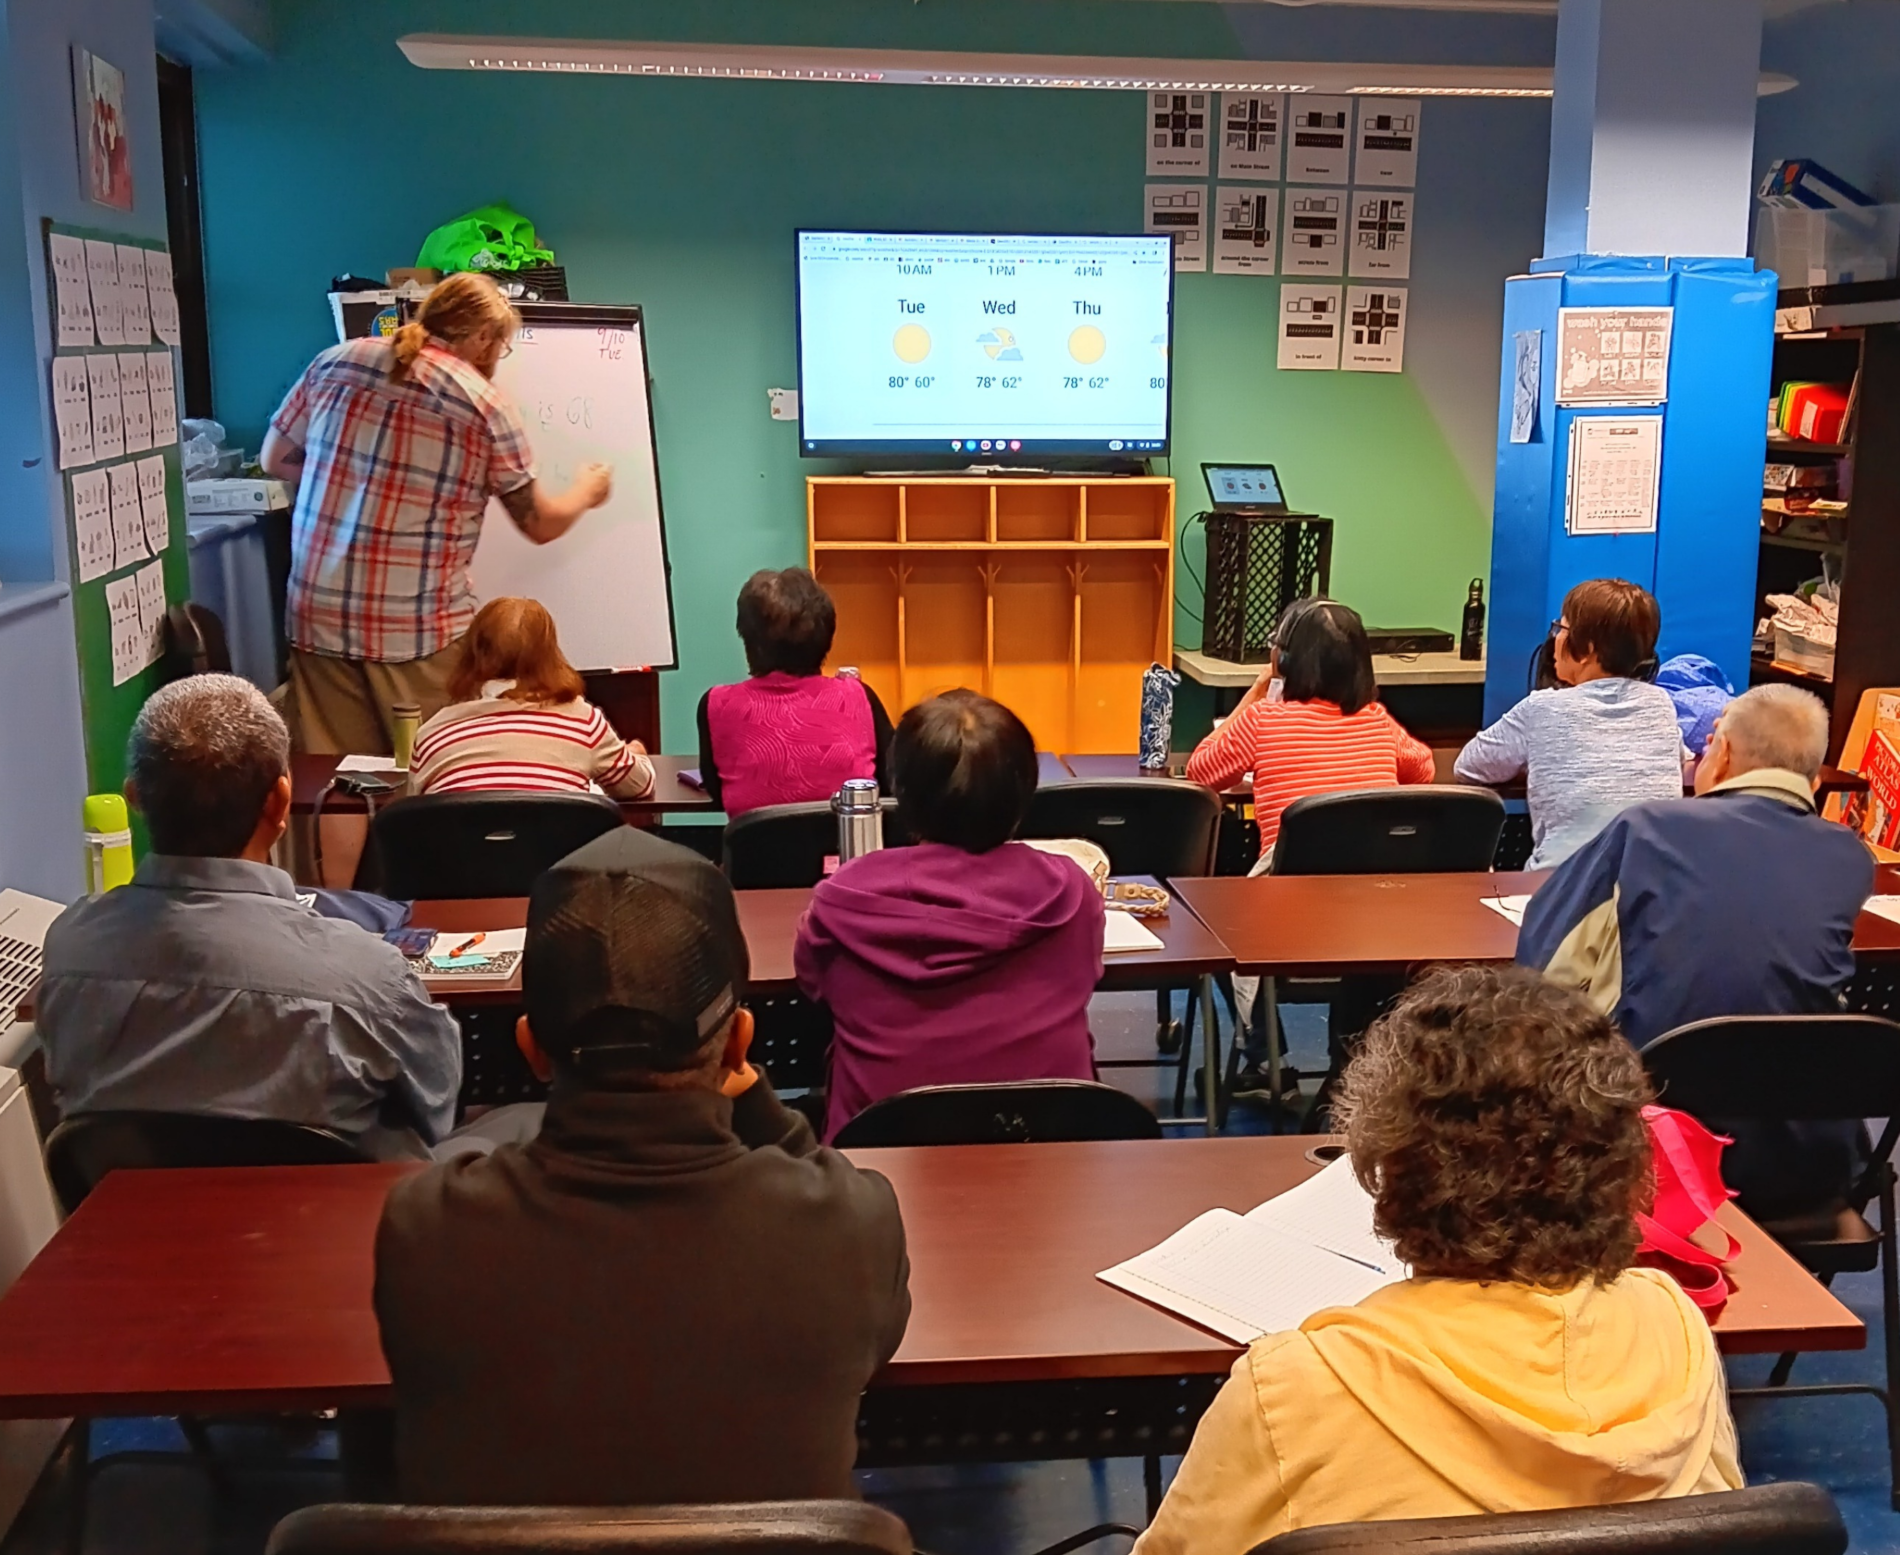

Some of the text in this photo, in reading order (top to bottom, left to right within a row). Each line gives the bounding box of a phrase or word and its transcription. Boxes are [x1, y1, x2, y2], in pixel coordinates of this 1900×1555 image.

[896, 264, 932, 275] 10 AM
[995, 265, 1016, 276] PM
[1083, 266, 1103, 277] PM
[897, 299, 926, 314] Tue
[983, 300, 1016, 315] Wed
[1072, 300, 1101, 315] Thu
[1566, 315, 1668, 330] wash your hands
[597, 326, 625, 350] 9/10
[1873, 755, 1900, 790] ATLAS
[1867, 765, 1898, 810] WORLD
